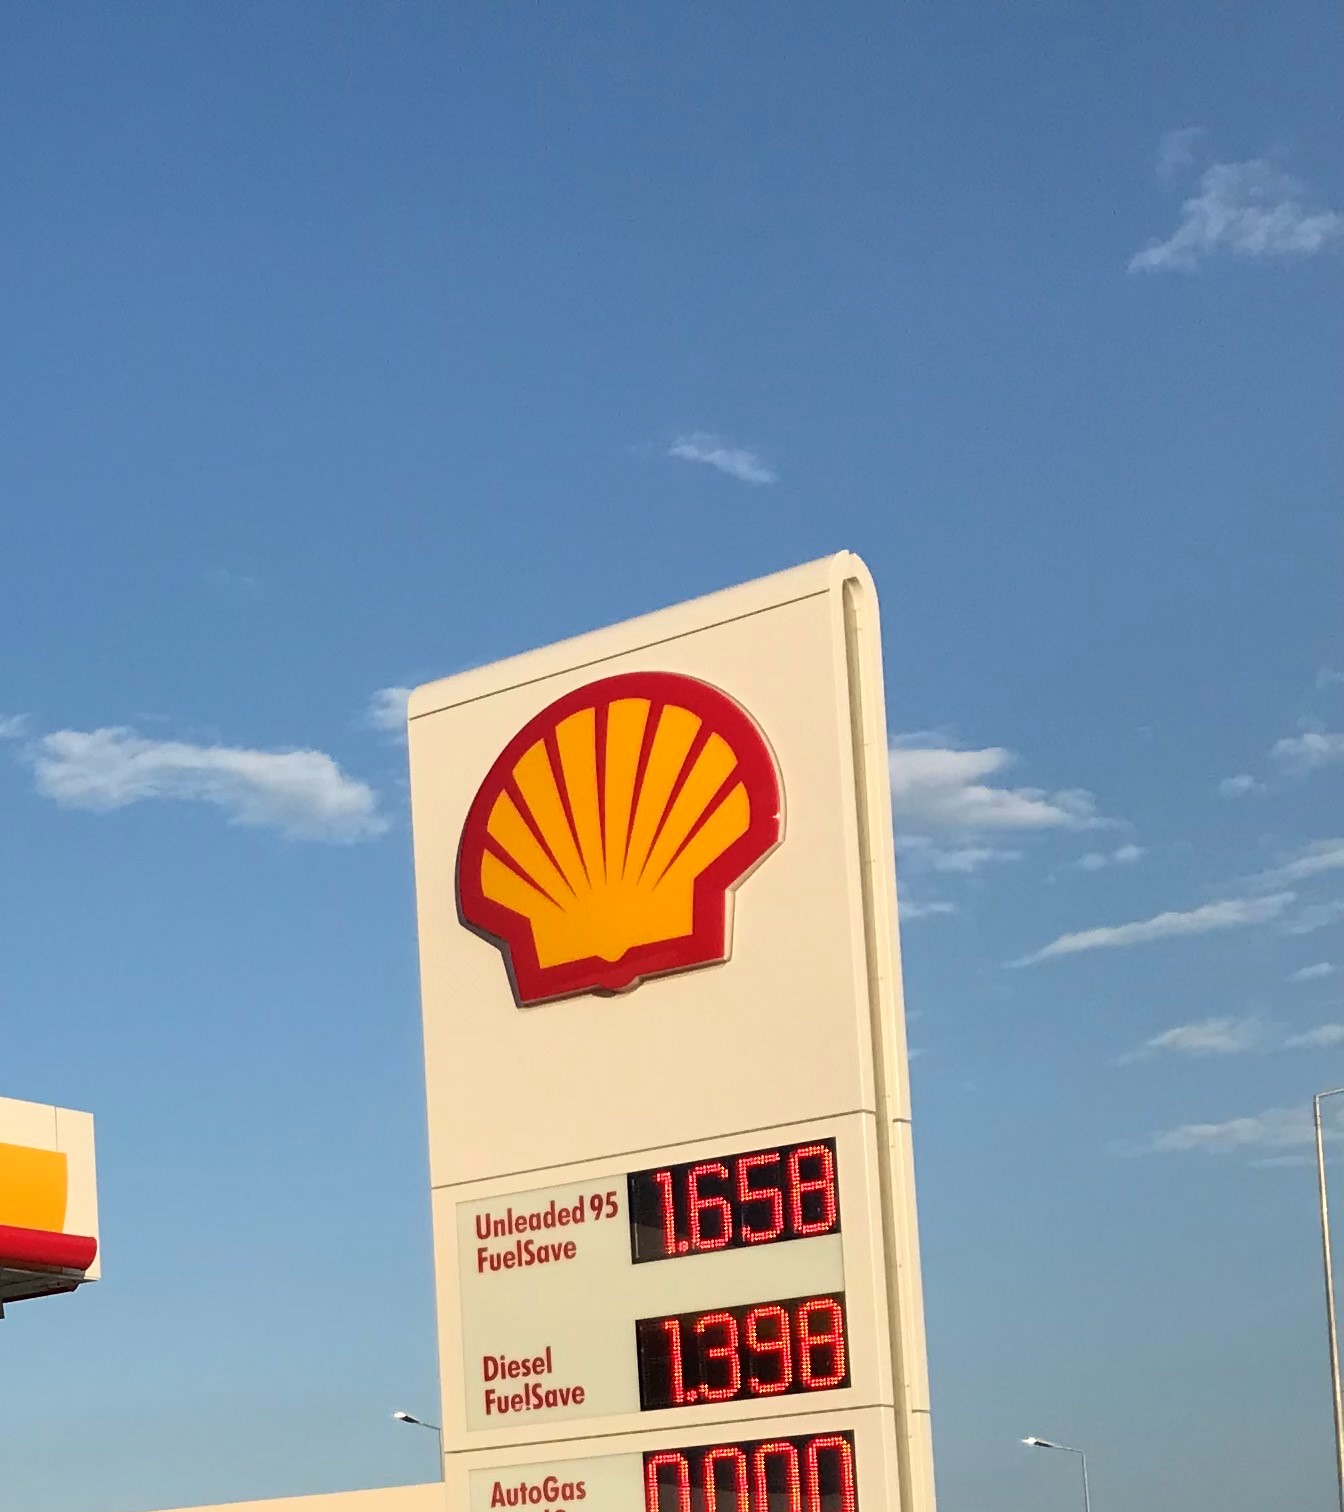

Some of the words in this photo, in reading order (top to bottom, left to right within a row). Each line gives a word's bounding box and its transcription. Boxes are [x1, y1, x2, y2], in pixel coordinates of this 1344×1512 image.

[475, 1193, 585, 1240] Unleaded
[589, 1192, 619, 1220] 95
[654, 1143, 838, 1257] 1.658
[477, 1237, 577, 1274] FuelSave
[483, 1347, 553, 1382] Diesel
[663, 1297, 846, 1404] 1.398
[484, 1383, 586, 1416] FuelSave
[490, 1476, 587, 1508] AutoGas
